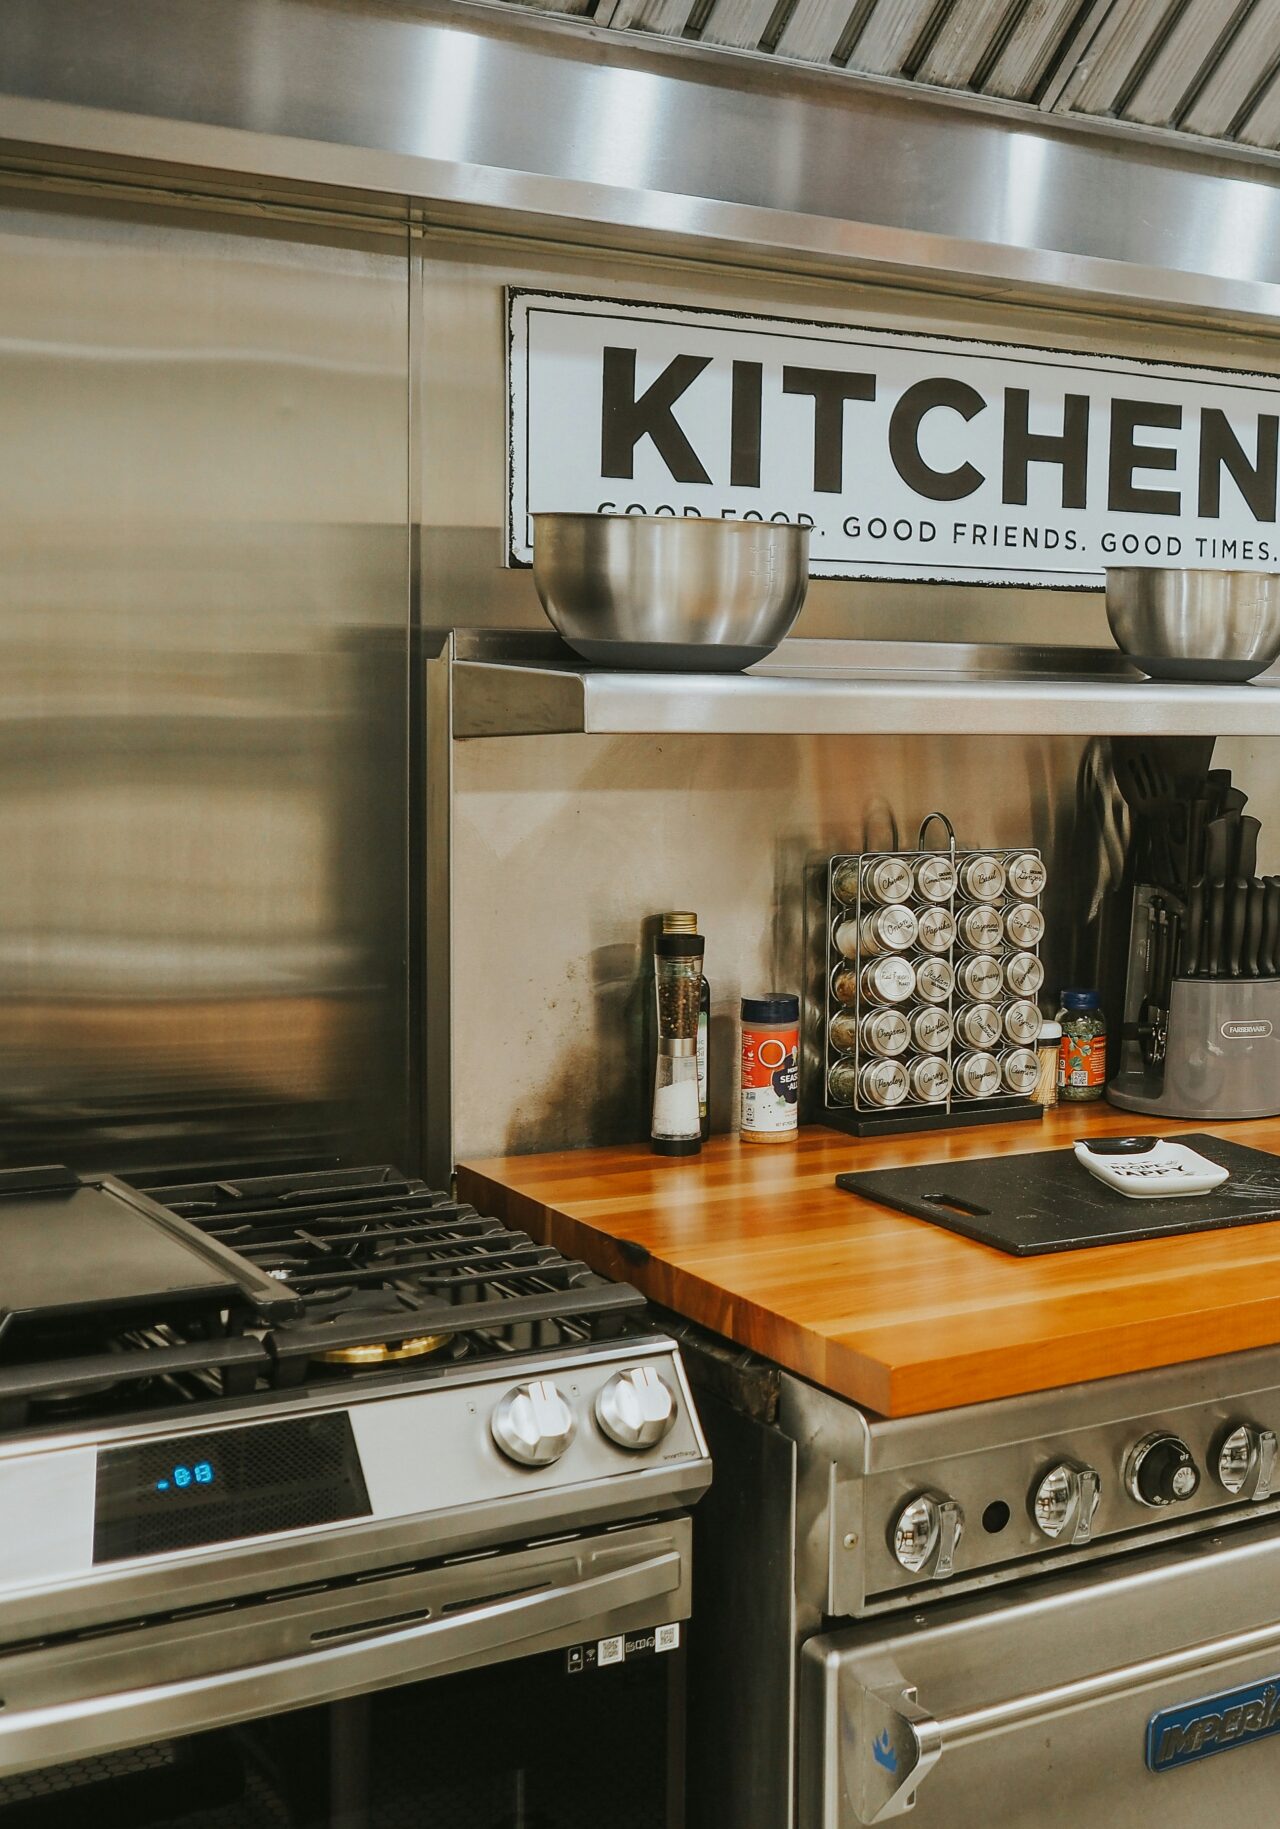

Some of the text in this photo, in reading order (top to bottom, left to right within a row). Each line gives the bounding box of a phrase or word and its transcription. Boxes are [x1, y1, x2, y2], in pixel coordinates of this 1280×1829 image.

[601, 347, 1280, 523] KITCHEN
[842, 516, 937, 542] GOOD
[953, 522, 1087, 551] FRIENDS.
[1100, 532, 1183, 557] GOOD
[1195, 537, 1279, 562] TIMES.
[977, 869, 997, 885] Basil
[924, 920, 953, 937] Paprika
[971, 920, 999, 932] Cayenne
[1013, 1010, 1035, 1030] Thyme
[1229, 1025, 1267, 1034] FARBERWARE
[878, 1075, 903, 1089] Parsley
